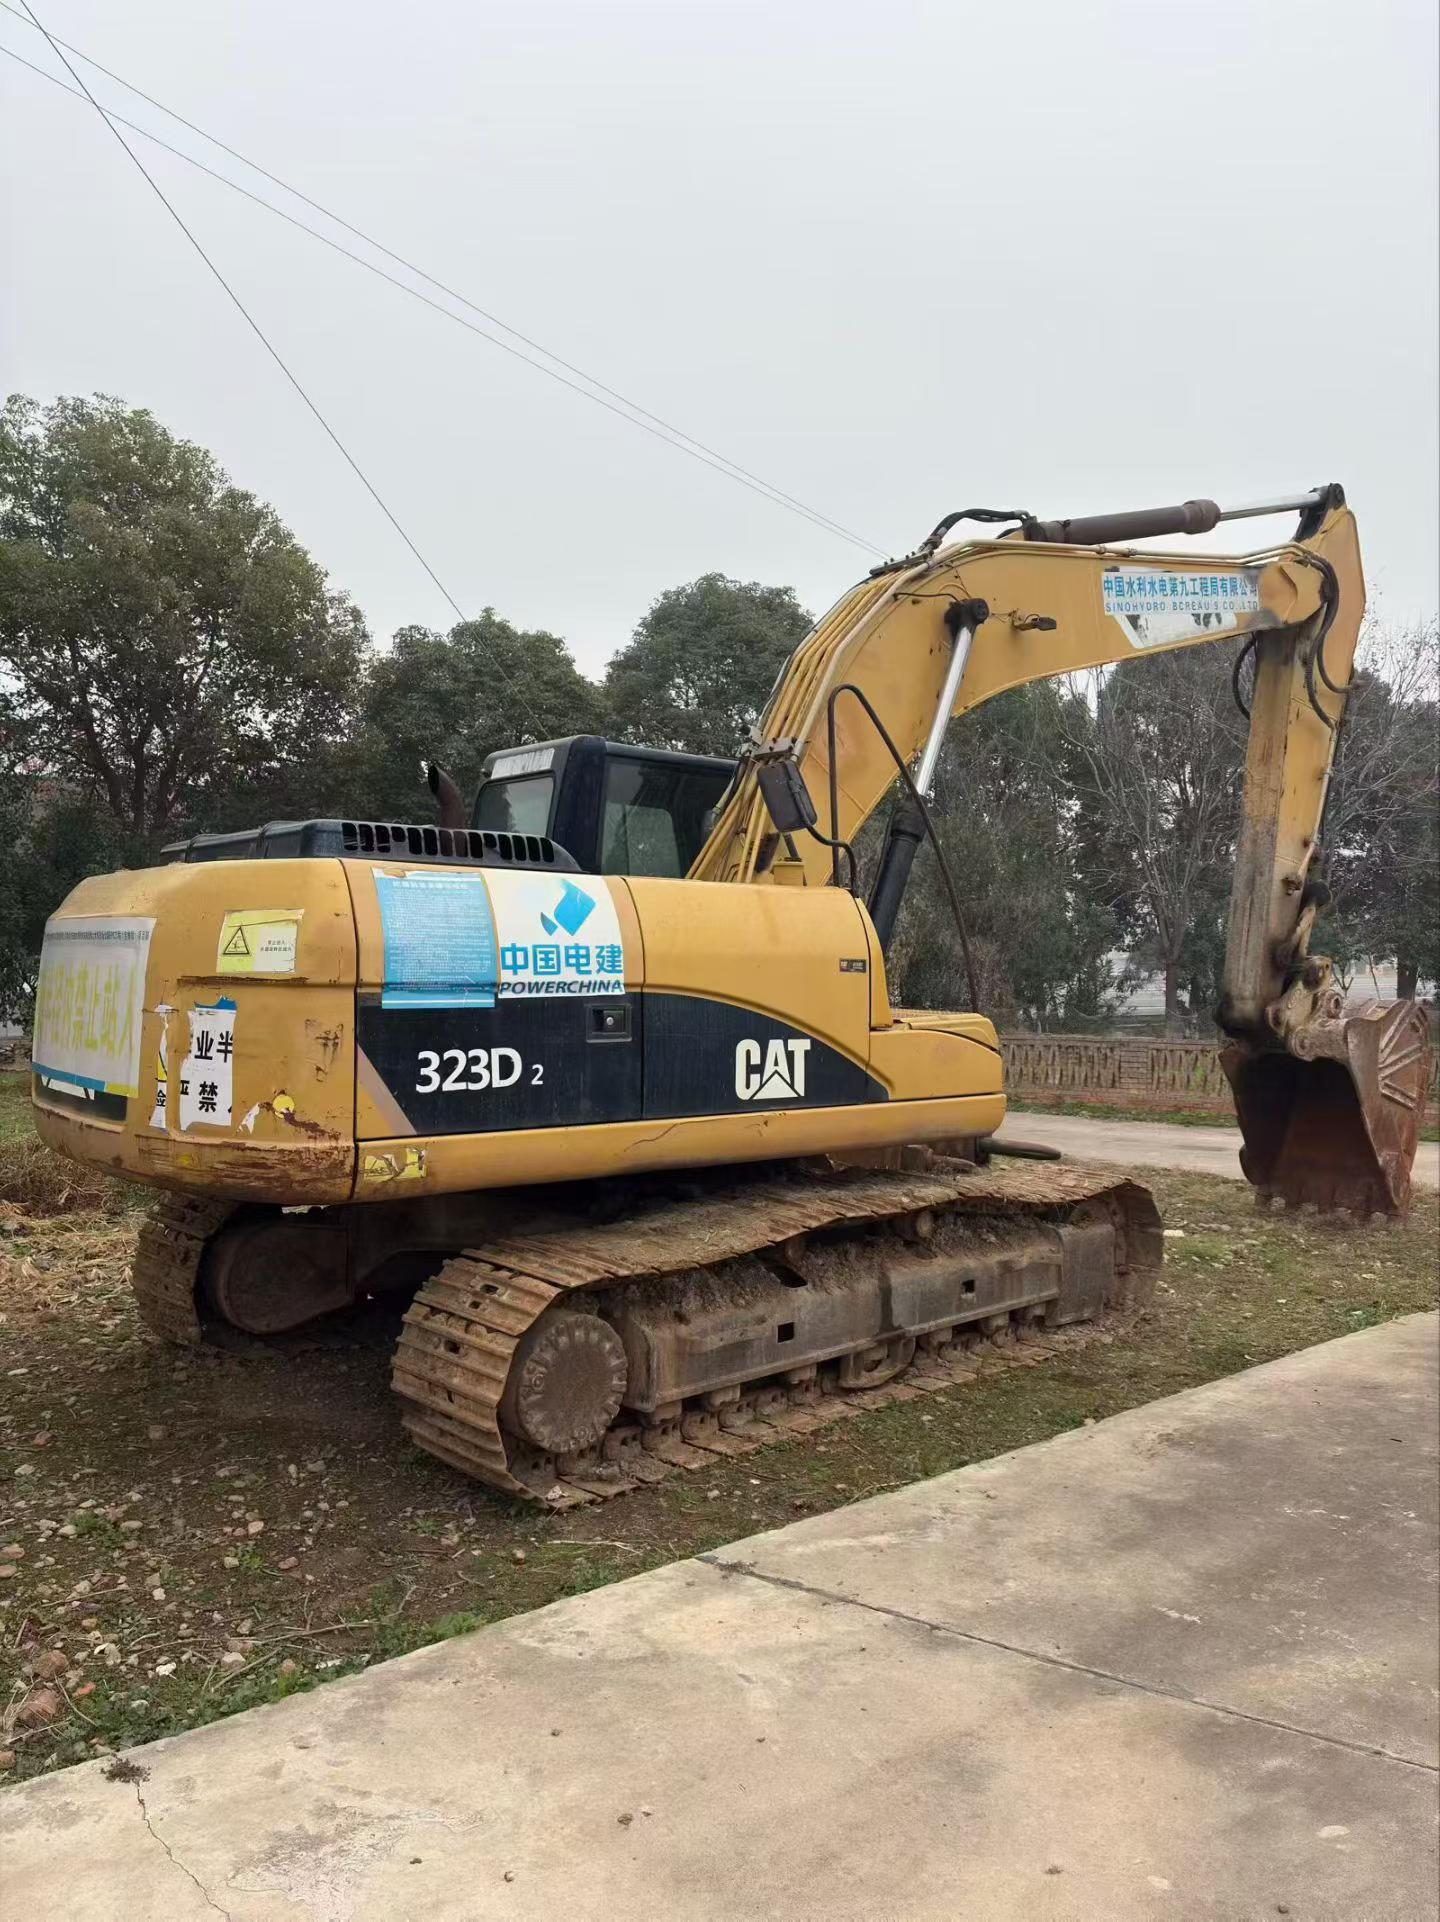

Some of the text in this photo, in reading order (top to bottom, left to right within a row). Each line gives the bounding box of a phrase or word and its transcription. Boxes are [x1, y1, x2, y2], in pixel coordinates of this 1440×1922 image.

[500, 943, 623, 976] 中国电建
[499, 979, 623, 994] POWERCHINA
[415, 1046, 544, 1094] 323D 2
[734, 1038, 811, 1101] CAT
